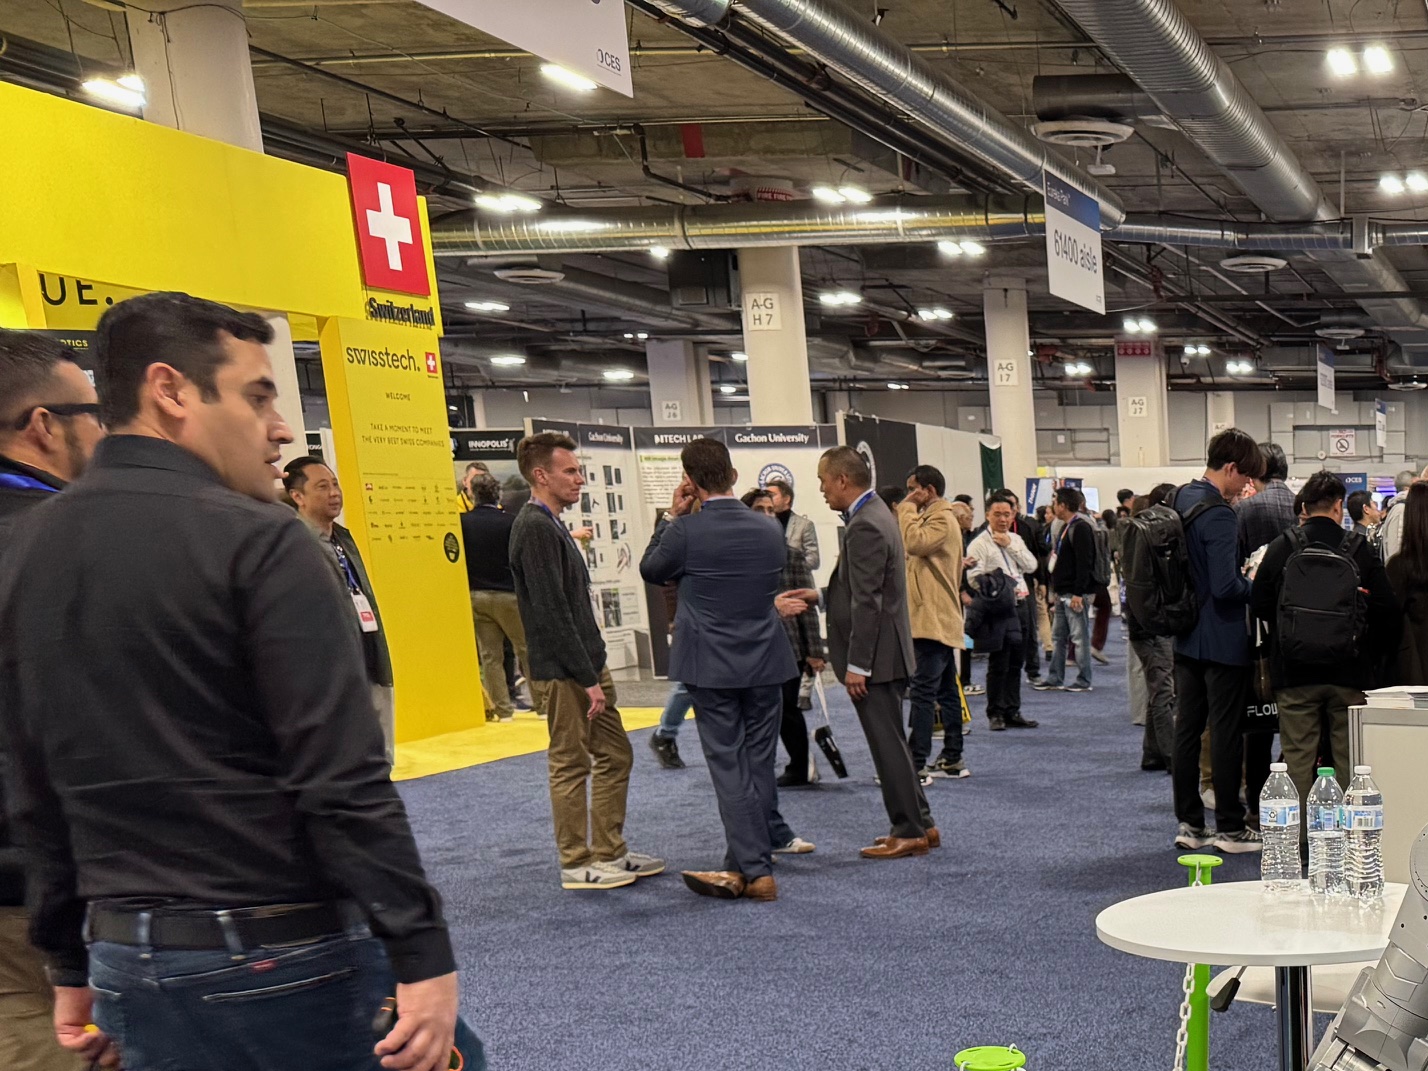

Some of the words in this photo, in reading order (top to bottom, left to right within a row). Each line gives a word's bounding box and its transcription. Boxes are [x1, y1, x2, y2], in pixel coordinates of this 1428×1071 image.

[605, 51, 621, 71] CES
[1054, 229, 1079, 265] 61400
[1080, 243, 1098, 274] aisle
[751, 297, 774, 310] A-G
[368, 297, 436, 327] Switzerland
[753, 314, 762, 325] H
[765, 313, 773, 325] 7
[997, 362, 1014, 371] A-G
[385, 392, 411, 401] WELCOME
[370, 423, 383, 431] TAKE
[389, 425, 412, 433] MOMENT
[361, 435, 372, 443] THE
[416, 439, 445, 448] COMPANIES
[468, 439, 508, 448] INNOPOLIS
[735, 433, 768, 443] Gachon
[768, 433, 809, 444] University
